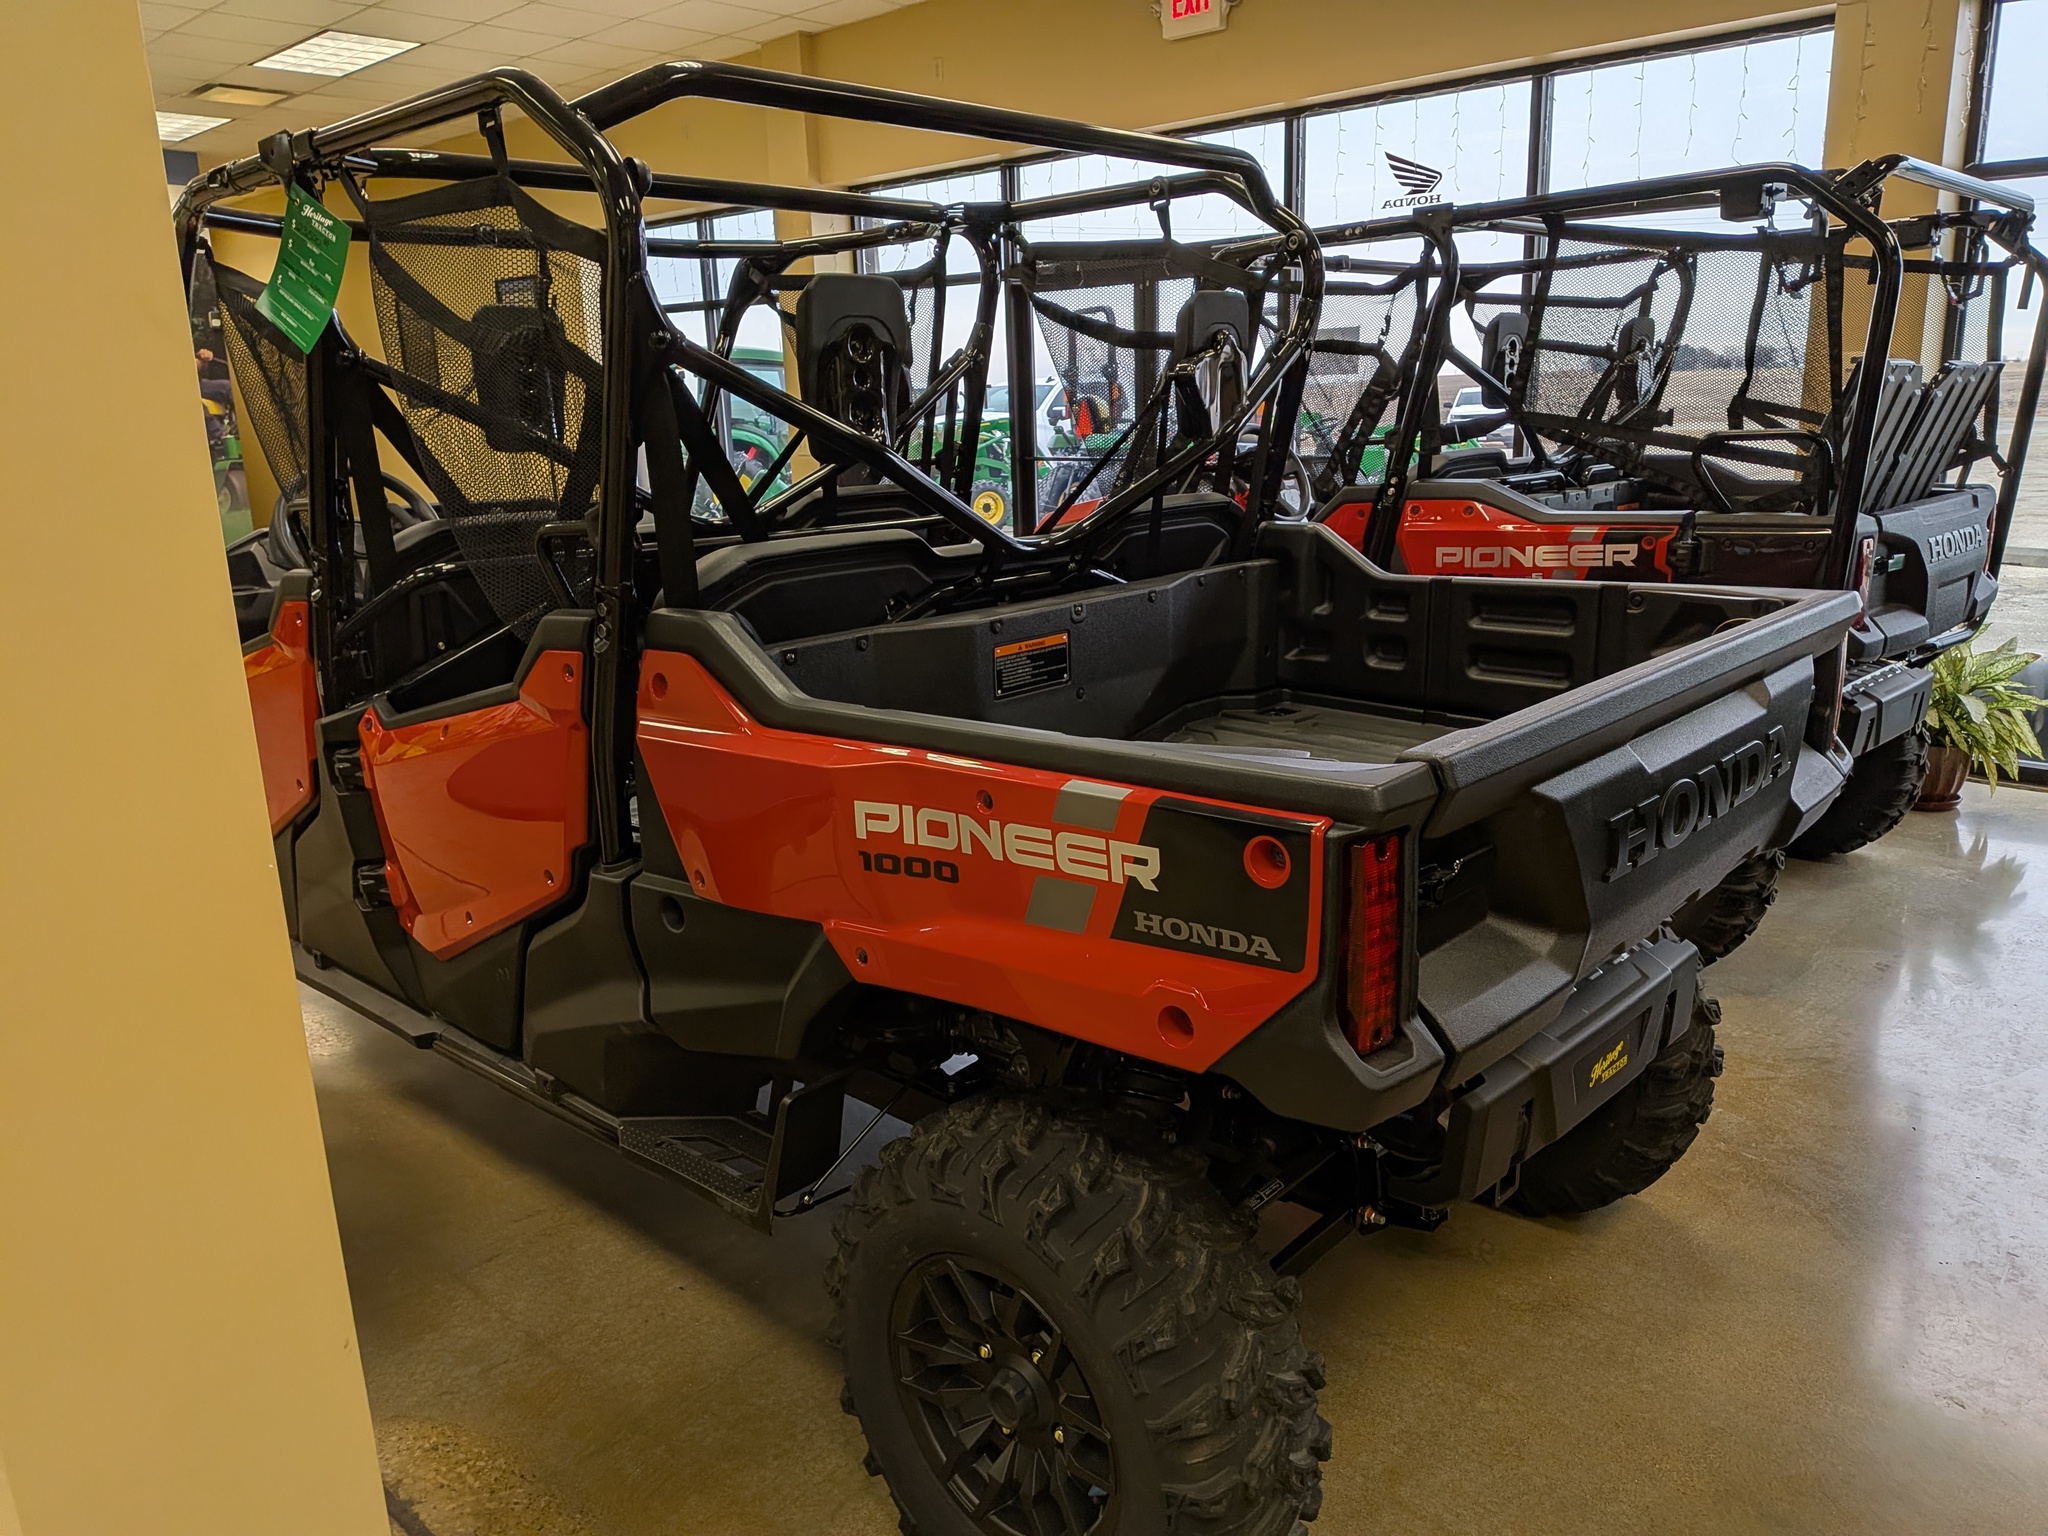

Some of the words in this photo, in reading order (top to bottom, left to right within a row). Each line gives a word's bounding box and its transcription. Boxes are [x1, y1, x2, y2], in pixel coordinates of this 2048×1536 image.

[301, 204, 334, 227] Heritage
[311, 219, 337, 243] TRACTOR
[1435, 543, 1639, 568] PIONEER
[1927, 524, 1985, 564] HONDA
[1024, 640, 1047, 650] WARNING
[1603, 725, 1790, 882] HONDA
[853, 800, 1161, 893] PIONEER
[858, 850, 960, 884] 1000
[1133, 910, 1281, 963] HONDA
[1588, 1040, 1624, 1088] Heritage
[1600, 1054, 1629, 1084] TRACTOR
